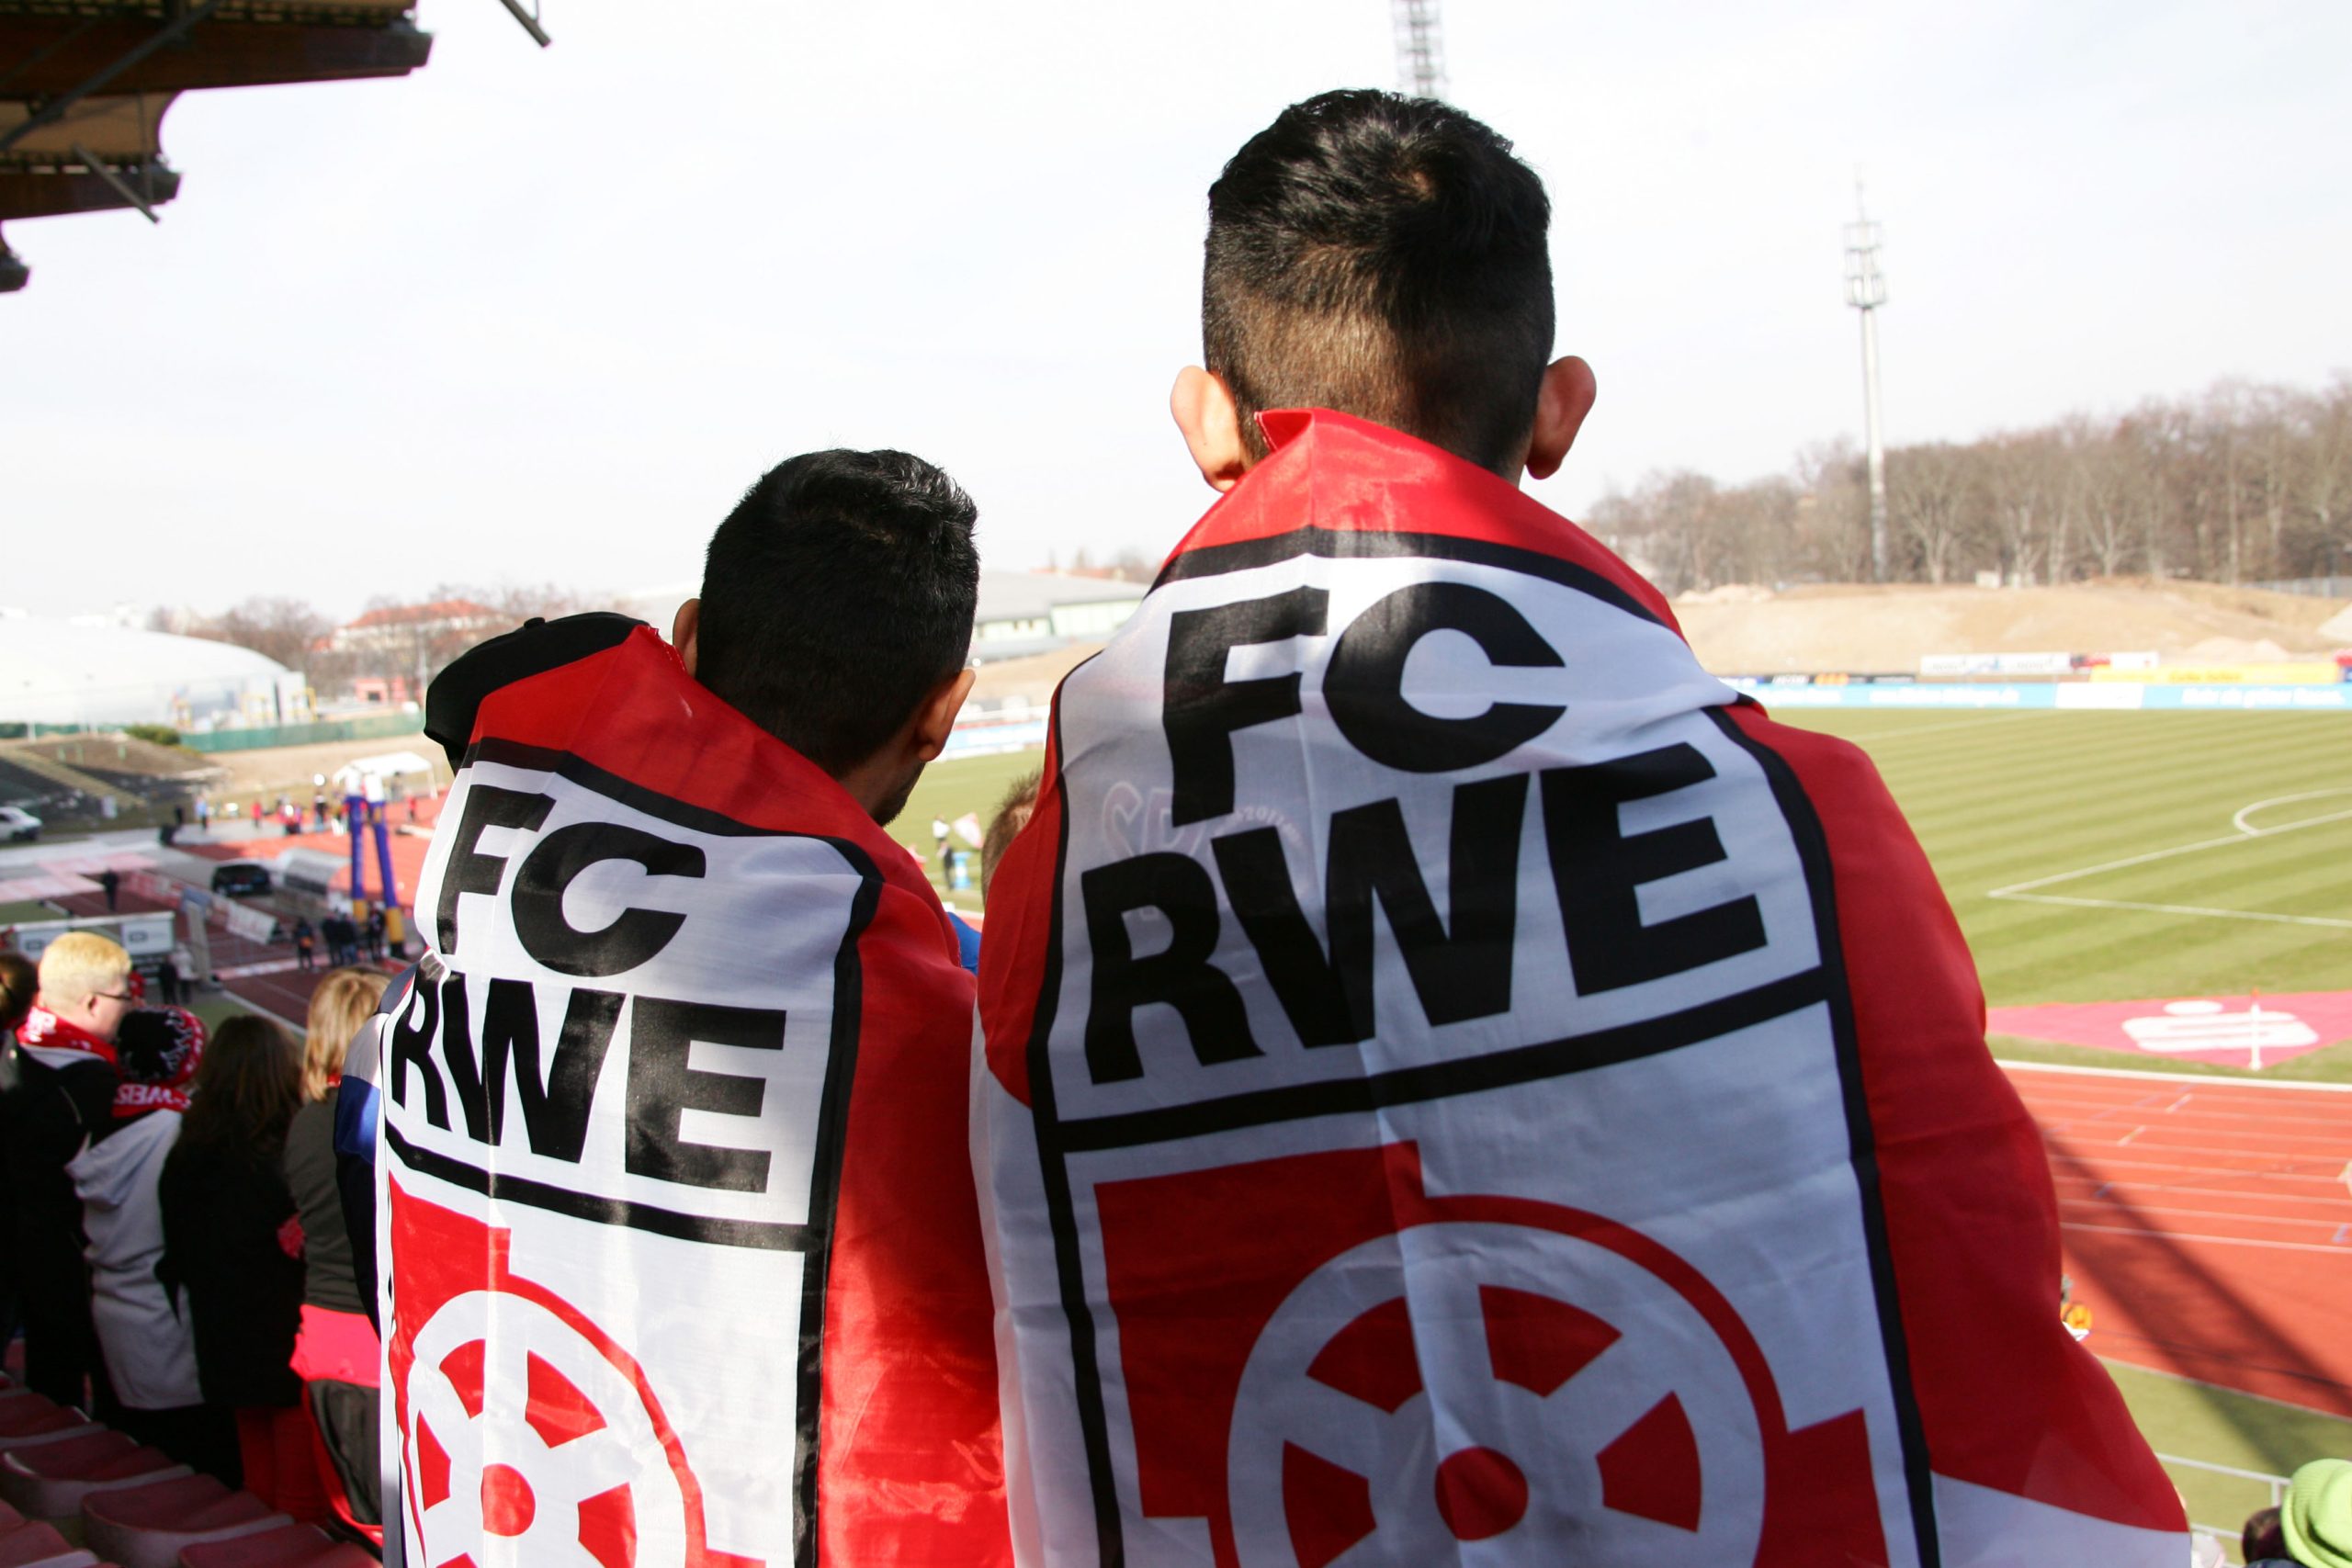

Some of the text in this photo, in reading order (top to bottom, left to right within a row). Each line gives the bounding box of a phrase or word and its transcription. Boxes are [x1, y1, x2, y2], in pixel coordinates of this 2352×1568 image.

[1162, 582, 1566, 828] FC
[436, 784, 707, 977] FC
[1081, 742, 1768, 1086] RWE
[390, 950, 786, 1194] RWE
